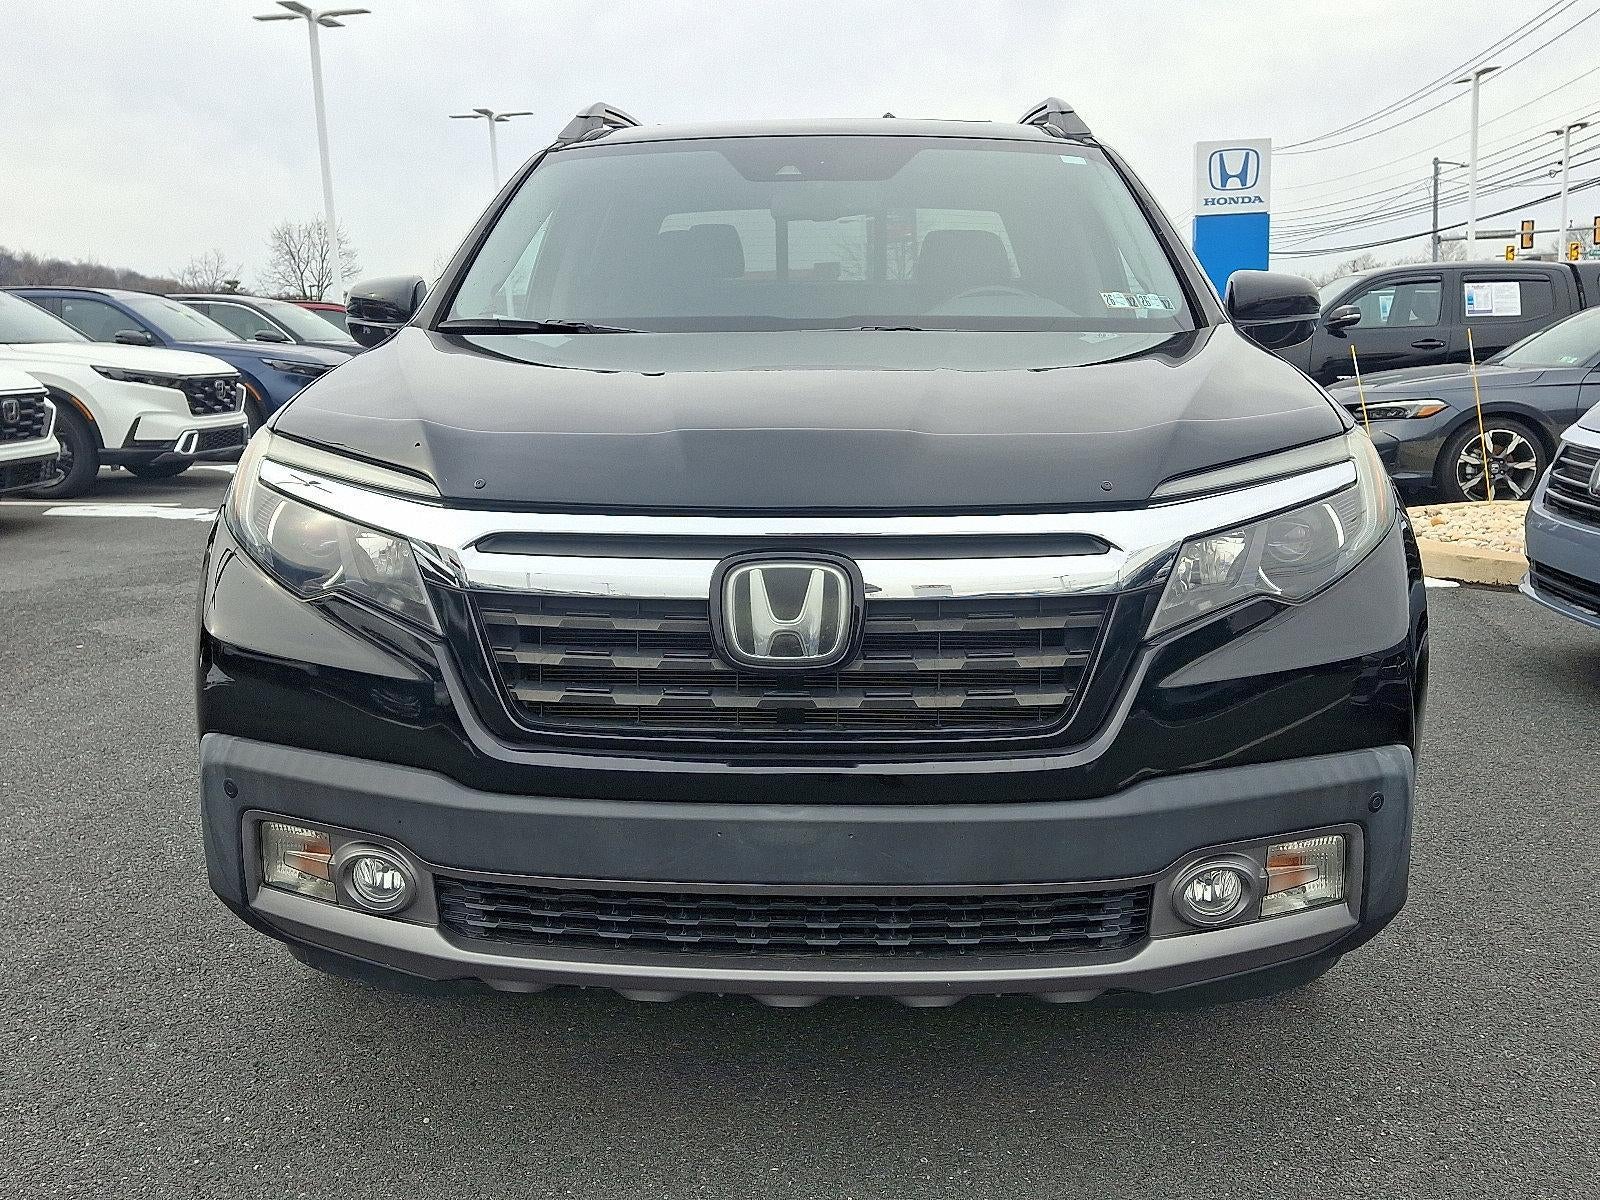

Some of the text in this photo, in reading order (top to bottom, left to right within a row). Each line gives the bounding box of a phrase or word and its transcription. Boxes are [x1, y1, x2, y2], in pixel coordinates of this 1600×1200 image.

[1203, 195, 1264, 206] HONDA
[1103, 294, 1116, 306] 26
[1139, 295, 1152, 307] 26
